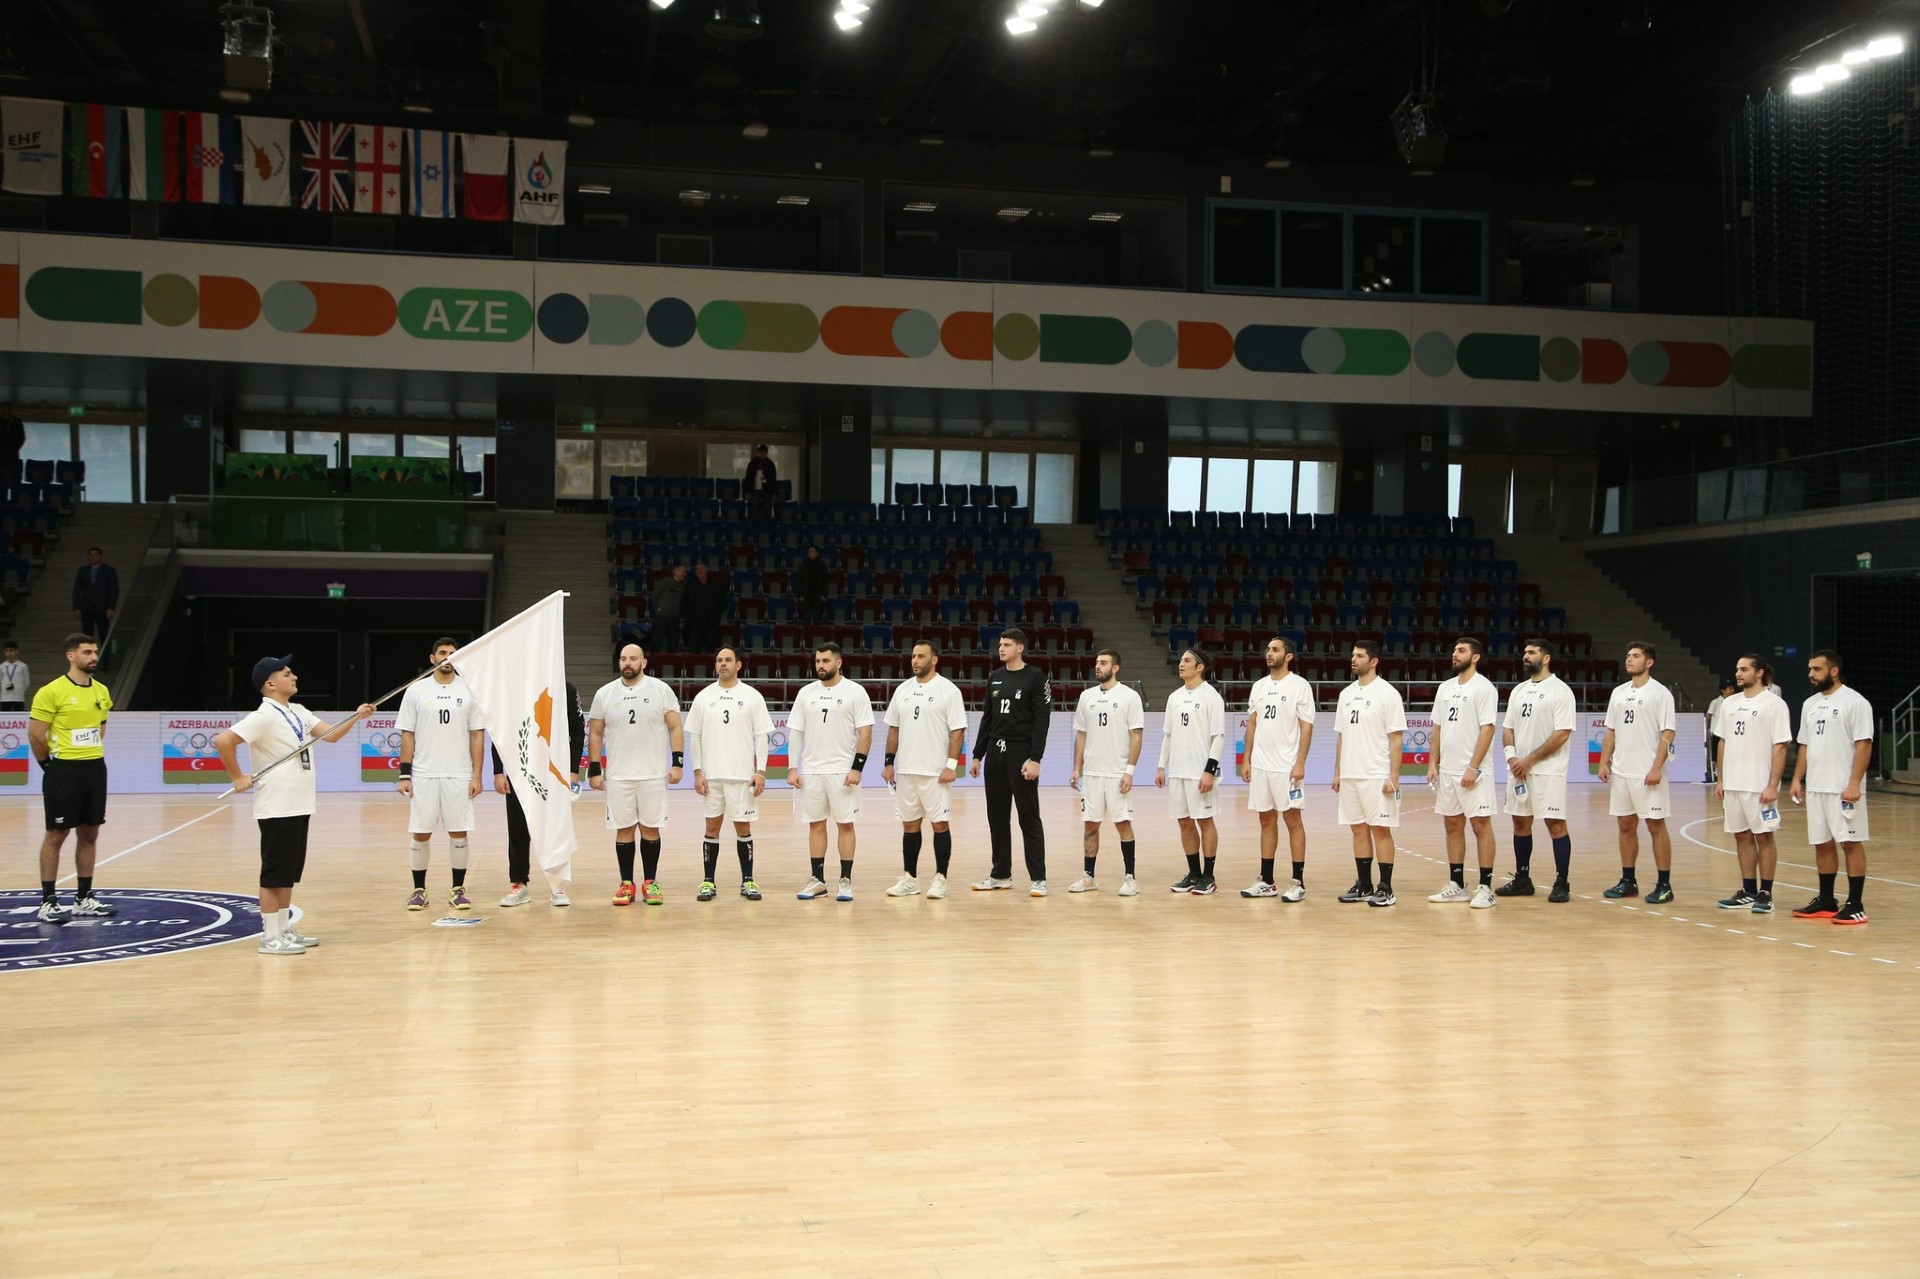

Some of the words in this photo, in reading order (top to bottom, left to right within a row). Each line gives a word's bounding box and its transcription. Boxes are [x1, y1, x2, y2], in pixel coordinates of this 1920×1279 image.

[8, 131, 42, 147] EHF
[520, 191, 560, 203] AHF
[422, 298, 508, 334] AZE
[913, 706, 919, 720] 9
[999, 699, 1010, 714] 12
[1264, 705, 1276, 719] 20
[1521, 703, 1533, 717] 23
[438, 709, 450, 724] 10
[628, 709, 636, 724] 2
[723, 710, 730, 724] 3
[821, 708, 828, 723] 7
[1098, 712, 1108, 726] 13
[1181, 712, 1189, 726] 19
[1350, 709, 1359, 724] 21
[1624, 709, 1634, 723] 29
[168, 720, 231, 729] AZERBAIJAN
[1734, 721, 1745, 735] 33
[1816, 719, 1826, 735] 37
[75, 732, 90, 741] EHF
[62, 919, 189, 927] Euro
